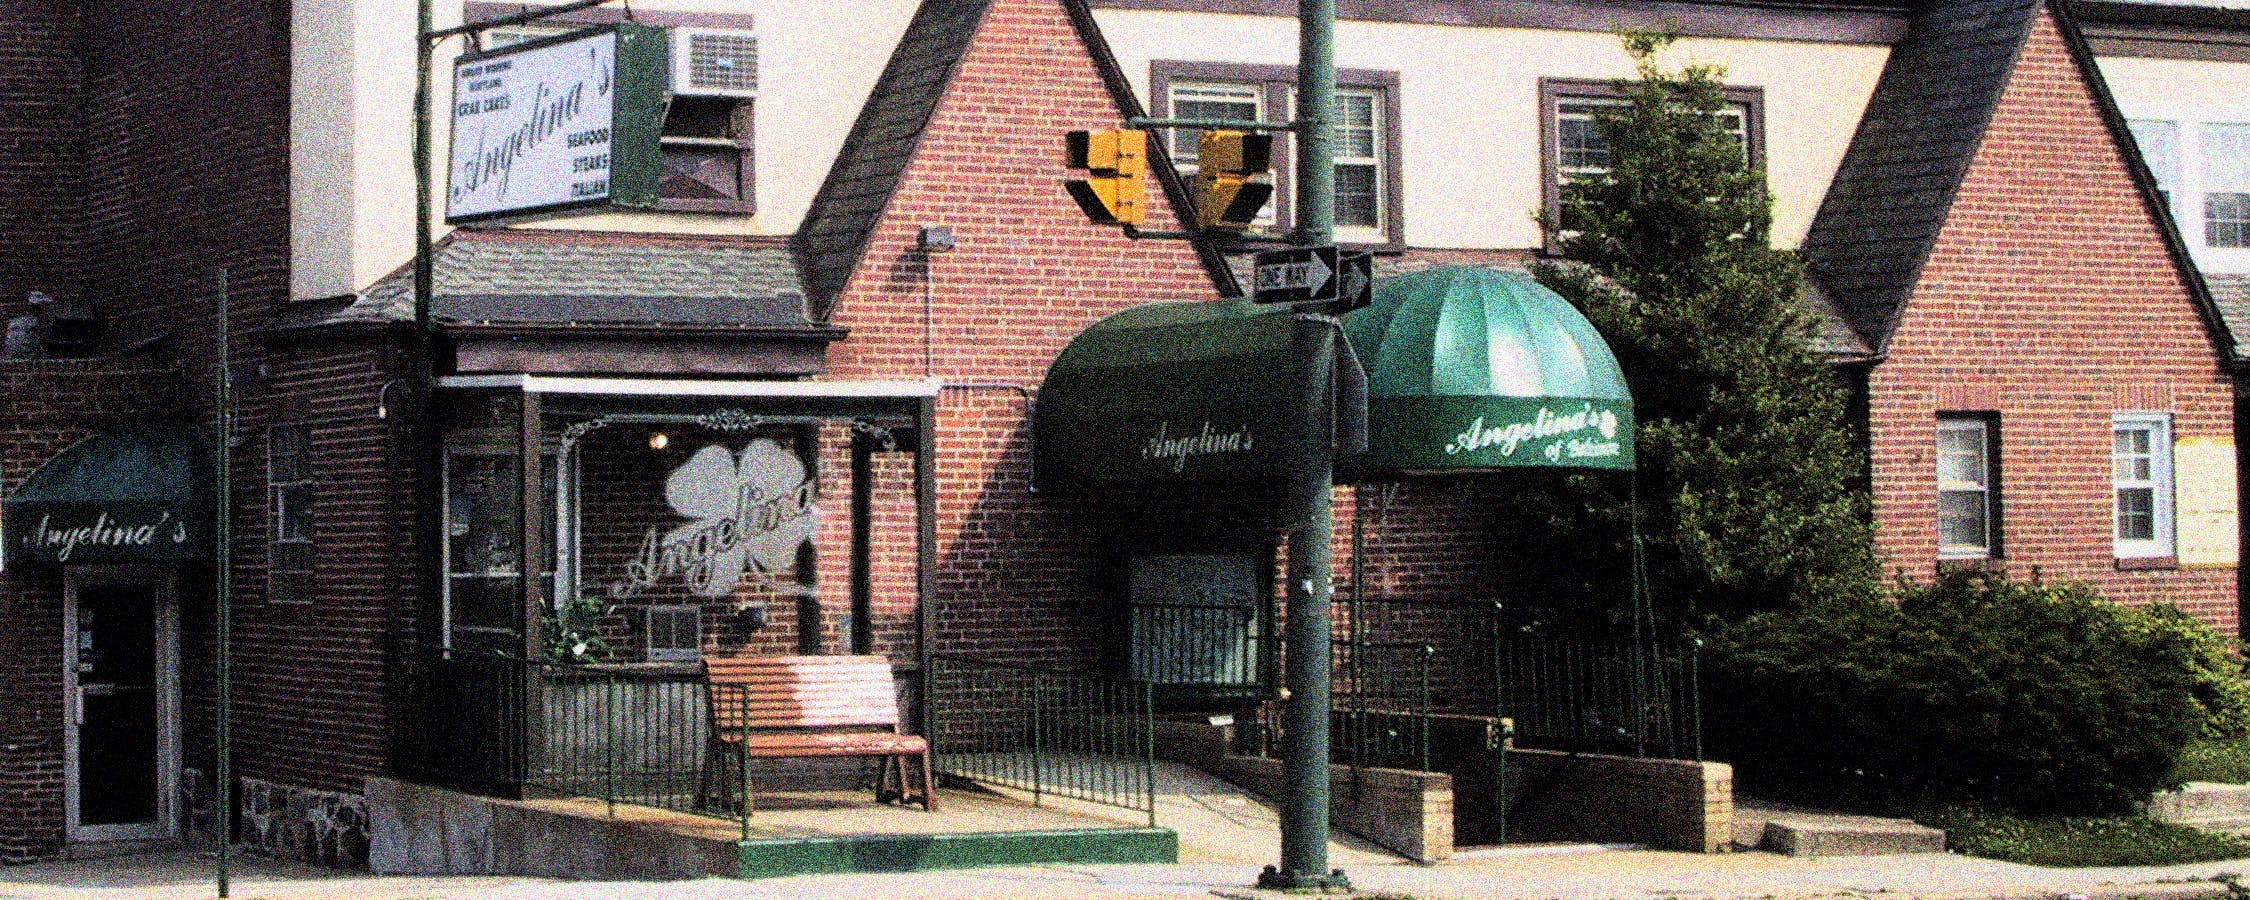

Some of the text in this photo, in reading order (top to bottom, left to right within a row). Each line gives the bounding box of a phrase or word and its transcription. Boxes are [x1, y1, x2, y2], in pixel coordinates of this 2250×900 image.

[452, 46, 611, 203] Angelina's
[567, 127, 609, 149] SEAFOOD
[572, 153, 608, 173] STEAKS
[1141, 419, 1254, 474] Angelina's
[1445, 401, 1599, 457] Angelina's
[22, 510, 188, 563] Angelina's
